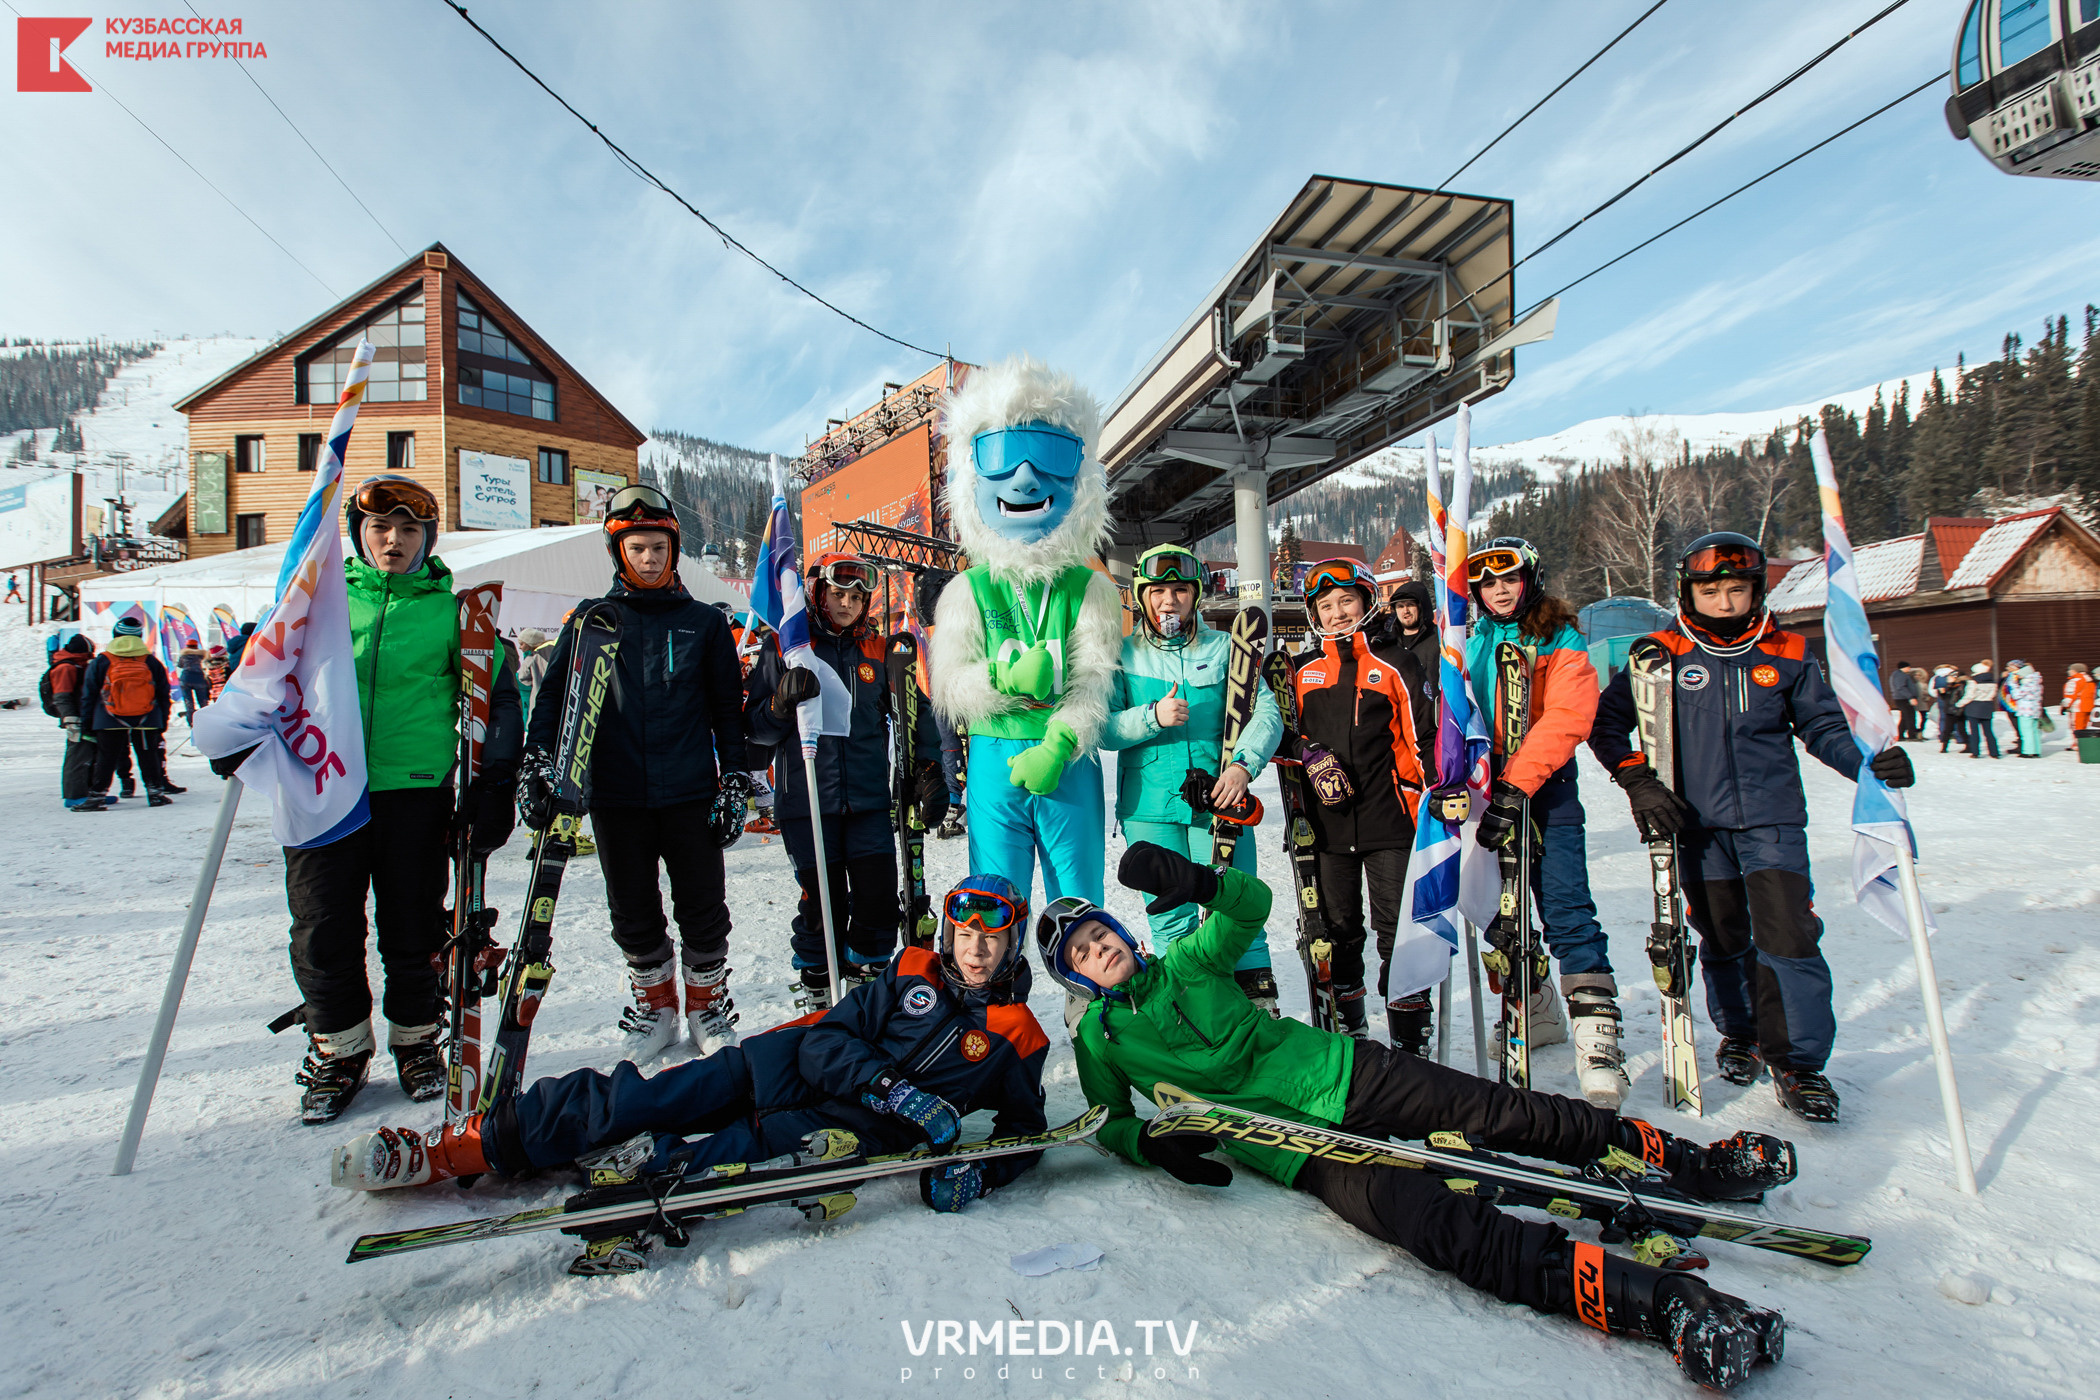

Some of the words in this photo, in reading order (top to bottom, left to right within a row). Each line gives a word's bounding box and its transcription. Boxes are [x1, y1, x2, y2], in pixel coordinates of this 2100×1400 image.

[475, 484, 483, 492] в
[486, 486, 516, 497] отель
[480, 474, 511, 486] Туры
[475, 492, 517, 506] Сугроб
[881, 491, 919, 524] FEST
[899, 515, 920, 530] ЧУДЕС
[570, 656, 612, 789] FISCHER
[1321, 775, 1341, 797] 24
[448, 1063, 462, 1100] SL
[1149, 1116, 1376, 1165] FISCHER
[1579, 1260, 1604, 1328] RC4
